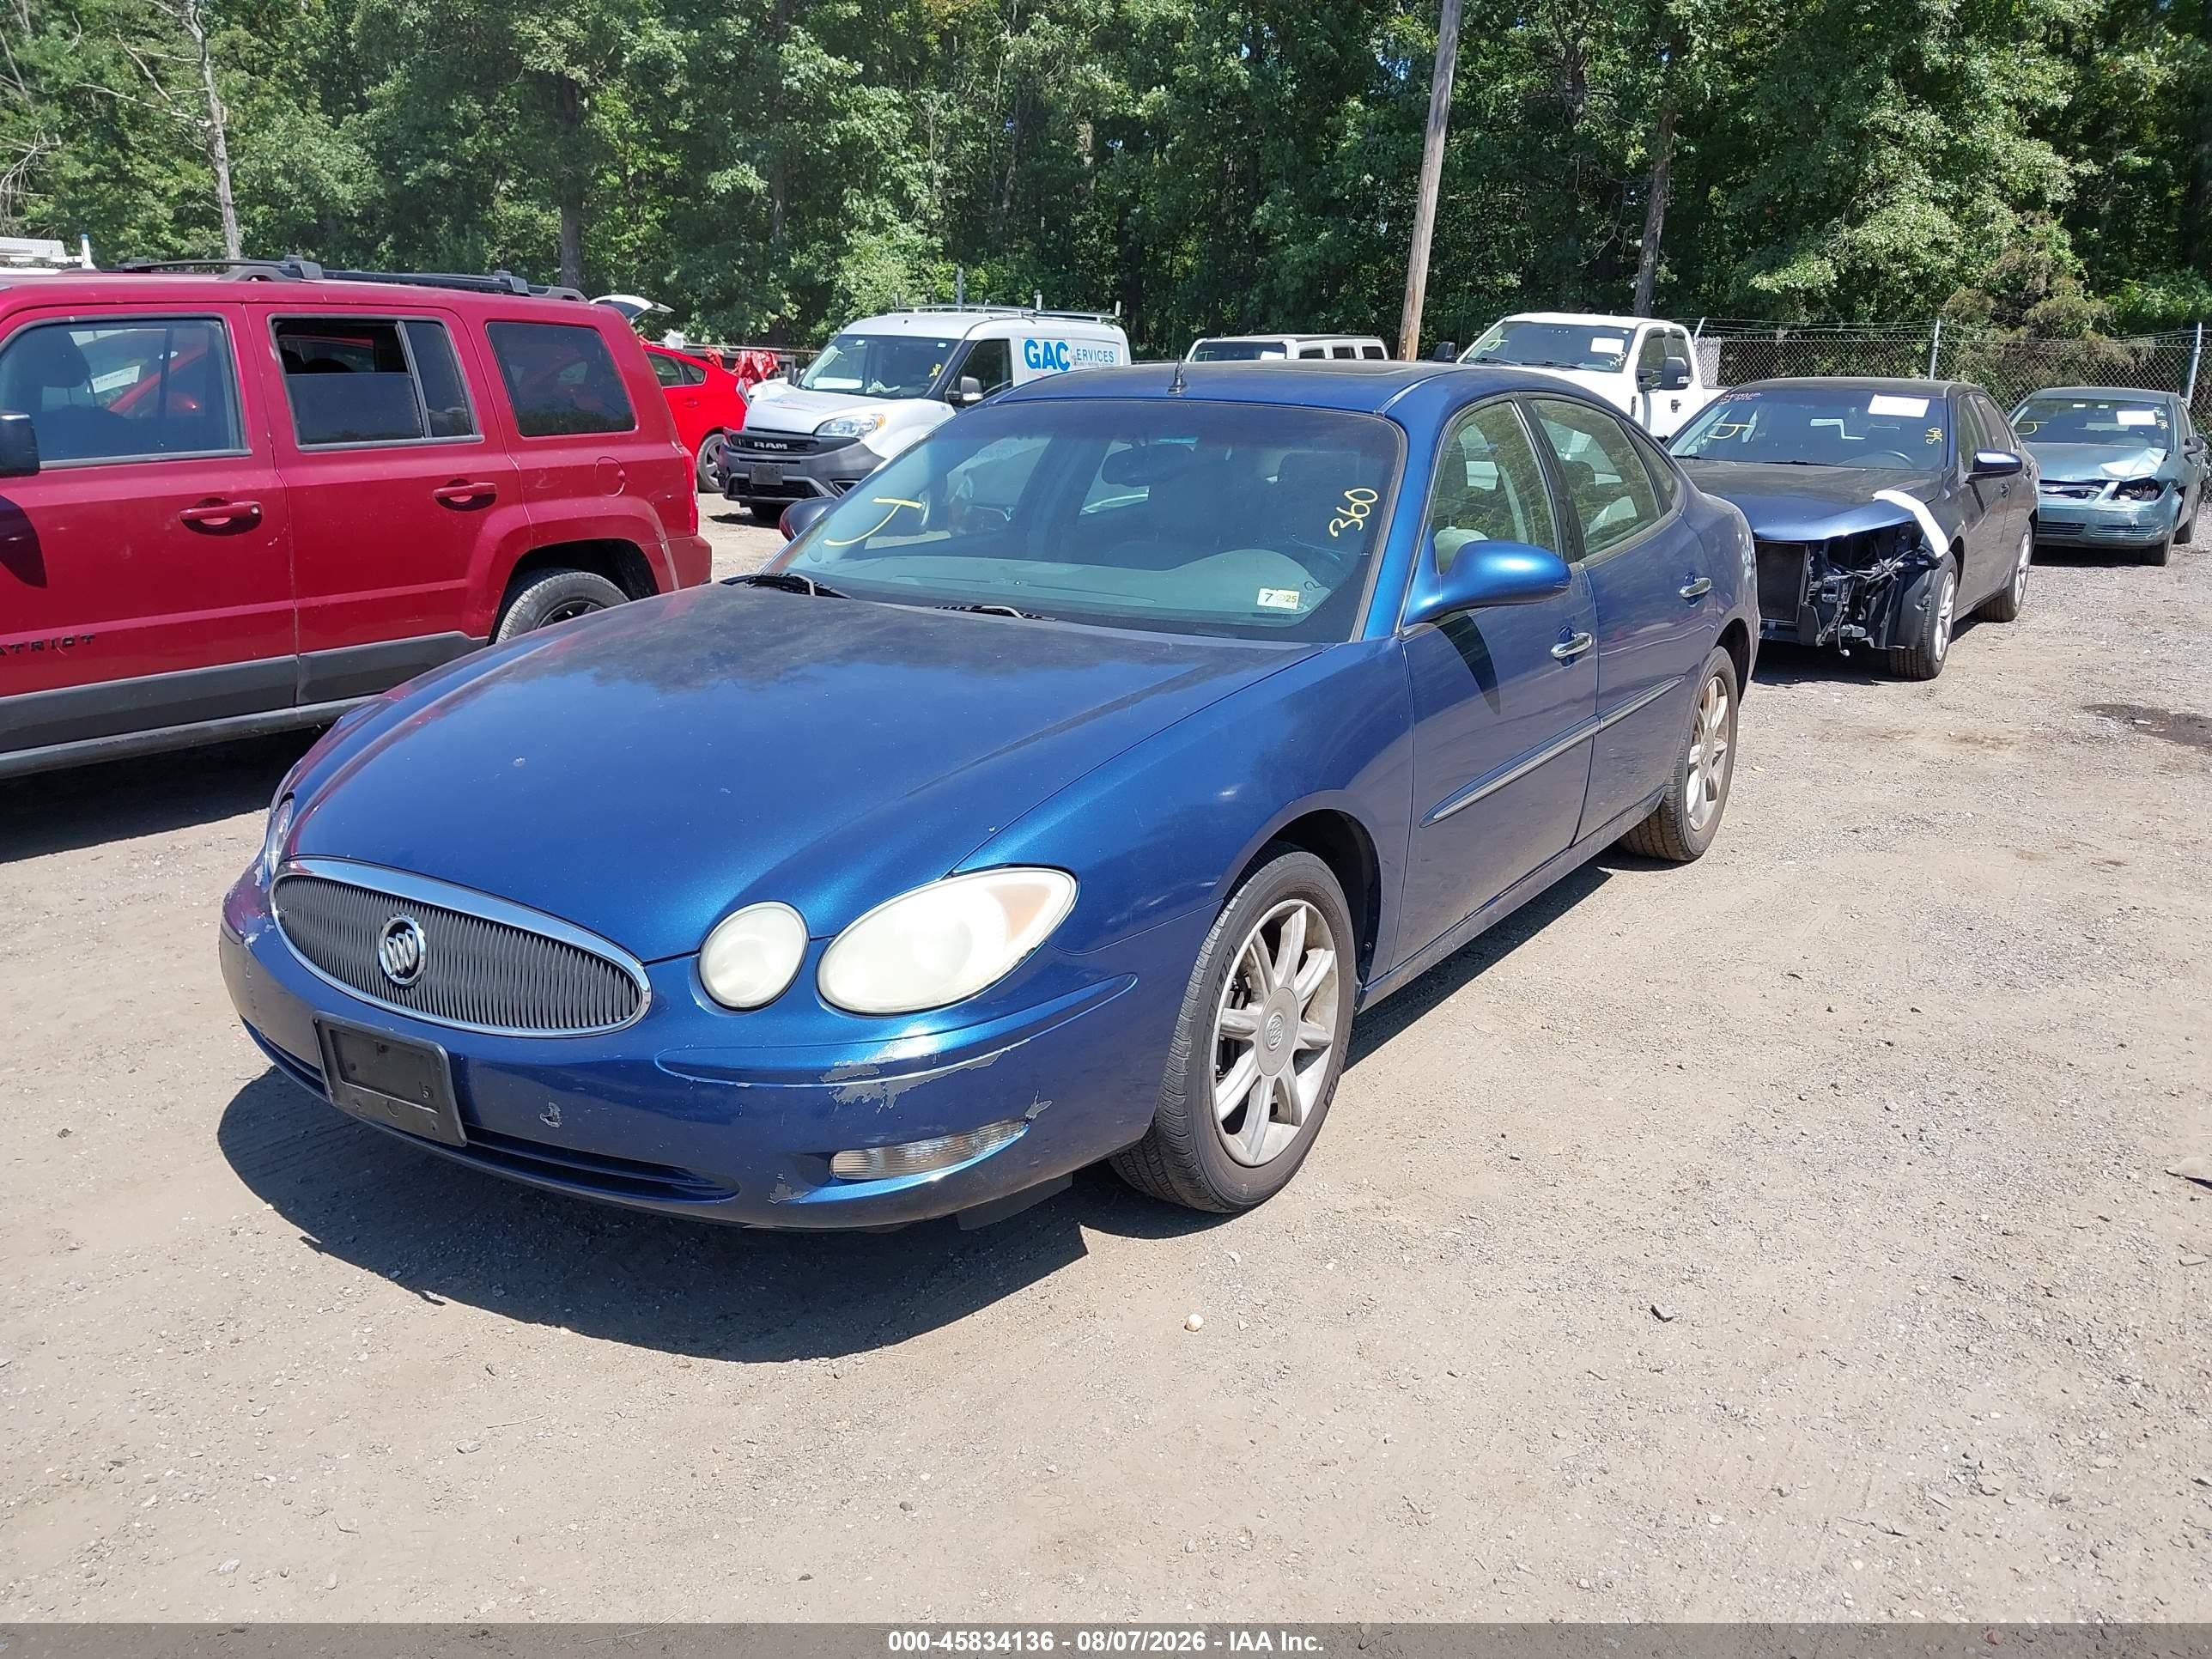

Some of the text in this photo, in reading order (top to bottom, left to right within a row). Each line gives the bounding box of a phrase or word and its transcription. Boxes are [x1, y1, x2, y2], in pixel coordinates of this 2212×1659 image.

[1024, 339, 1115, 371] GAC ERVICES
[754, 441, 788, 450] RAM
[1328, 488, 1378, 538] 360
[1264, 592, 1298, 604] 7 25
